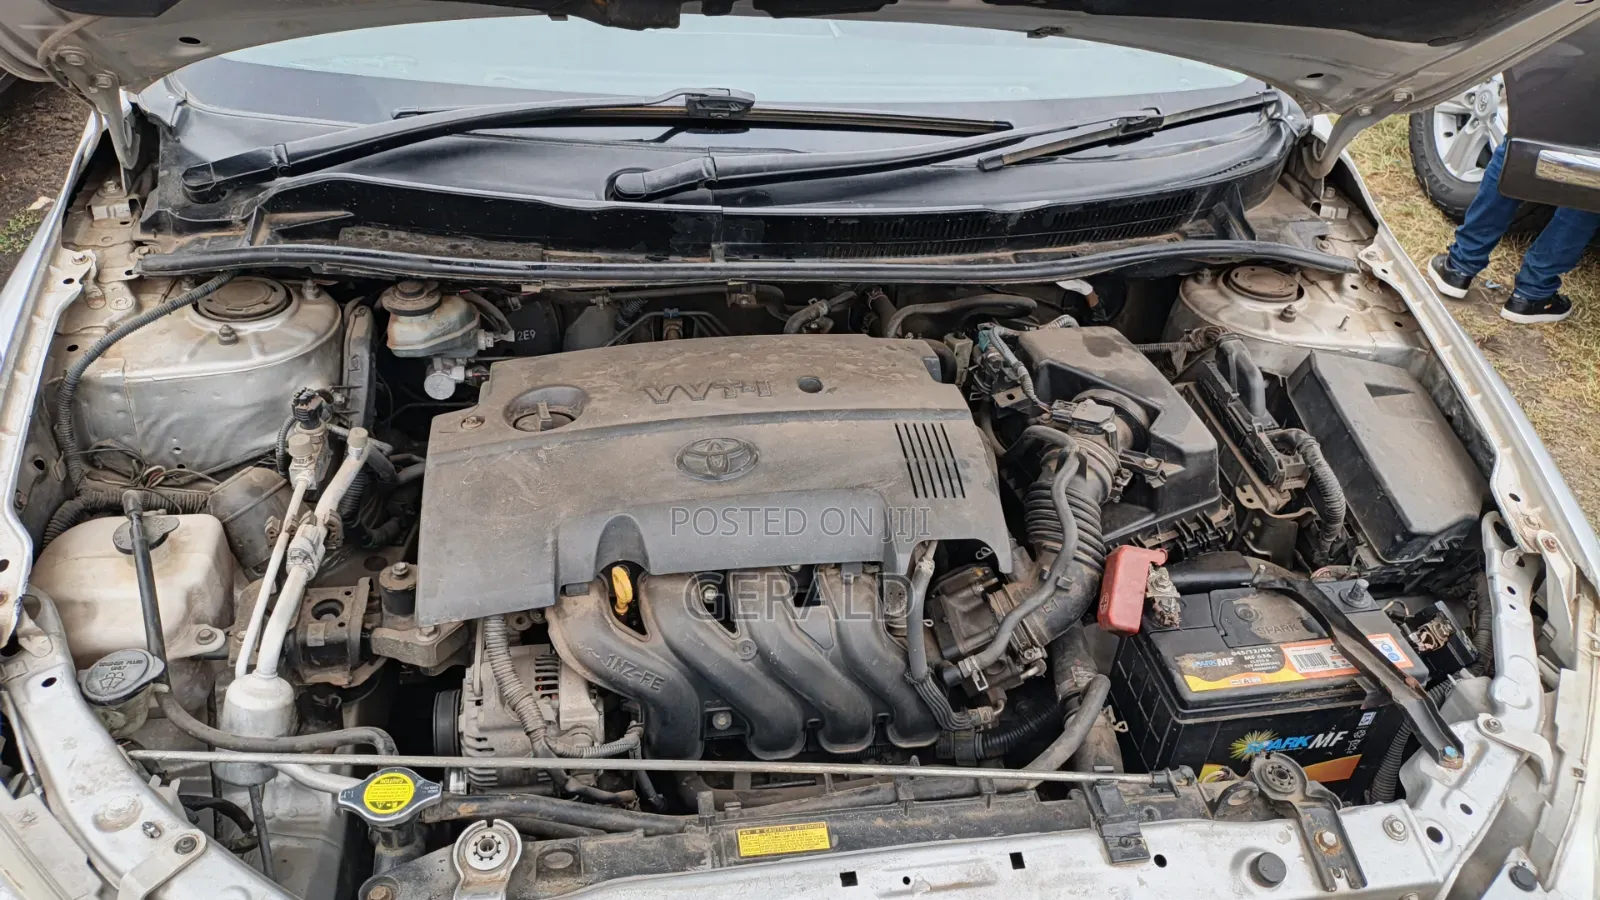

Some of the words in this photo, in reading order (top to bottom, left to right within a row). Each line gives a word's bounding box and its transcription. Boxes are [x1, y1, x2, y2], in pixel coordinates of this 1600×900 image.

[517, 329, 536, 341] 2E9
[1257, 623, 1299, 635] SPARK
[1216, 656, 1235, 667] MF
[604, 653, 664, 692] 1NZ-FE
[1308, 730, 1349, 750] MF
[795, 823, 825, 831] ATTENTION
